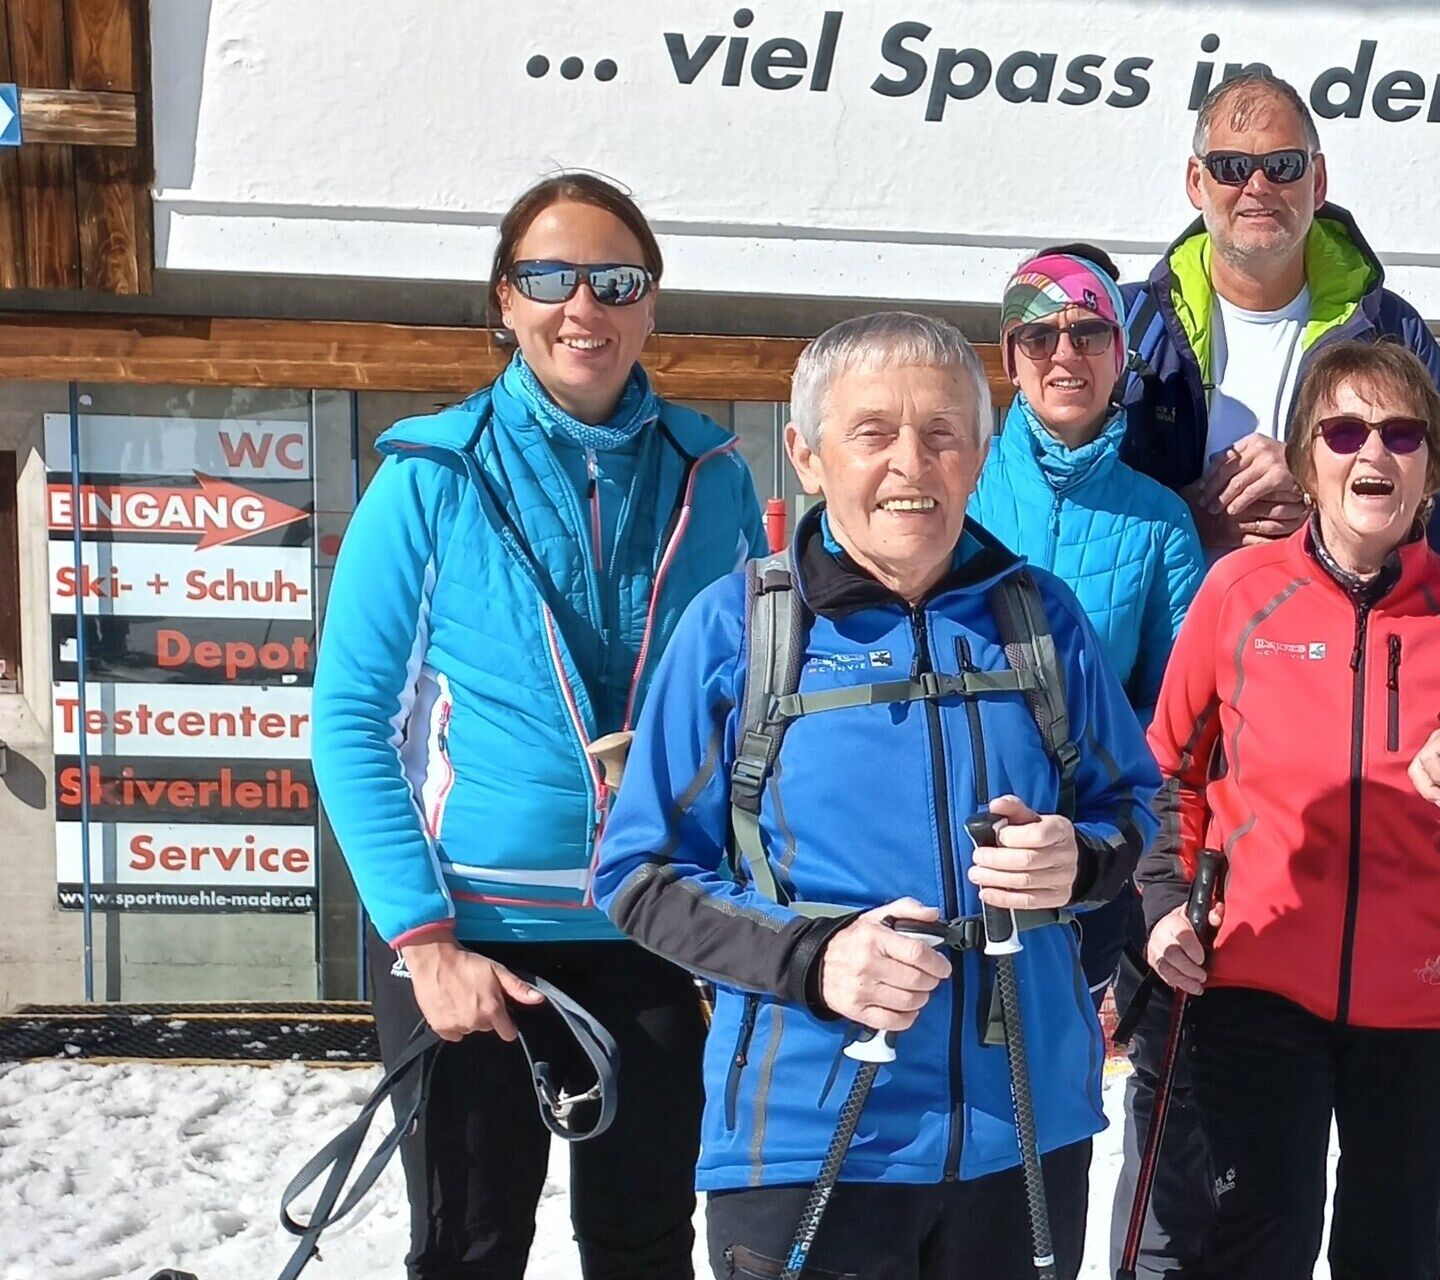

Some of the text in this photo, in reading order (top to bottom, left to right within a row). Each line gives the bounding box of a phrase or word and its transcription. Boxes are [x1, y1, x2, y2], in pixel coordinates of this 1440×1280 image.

[664, 8, 843, 91] viel
[871, 21, 1154, 121] Spass
[218, 431, 303, 470] WC
[186, 568, 308, 602] Schuh-
[157, 630, 309, 679] Depot
[56, 699, 309, 738] Testcenter
[60, 765, 309, 809] Skiverleih
[129, 834, 310, 873] Service
